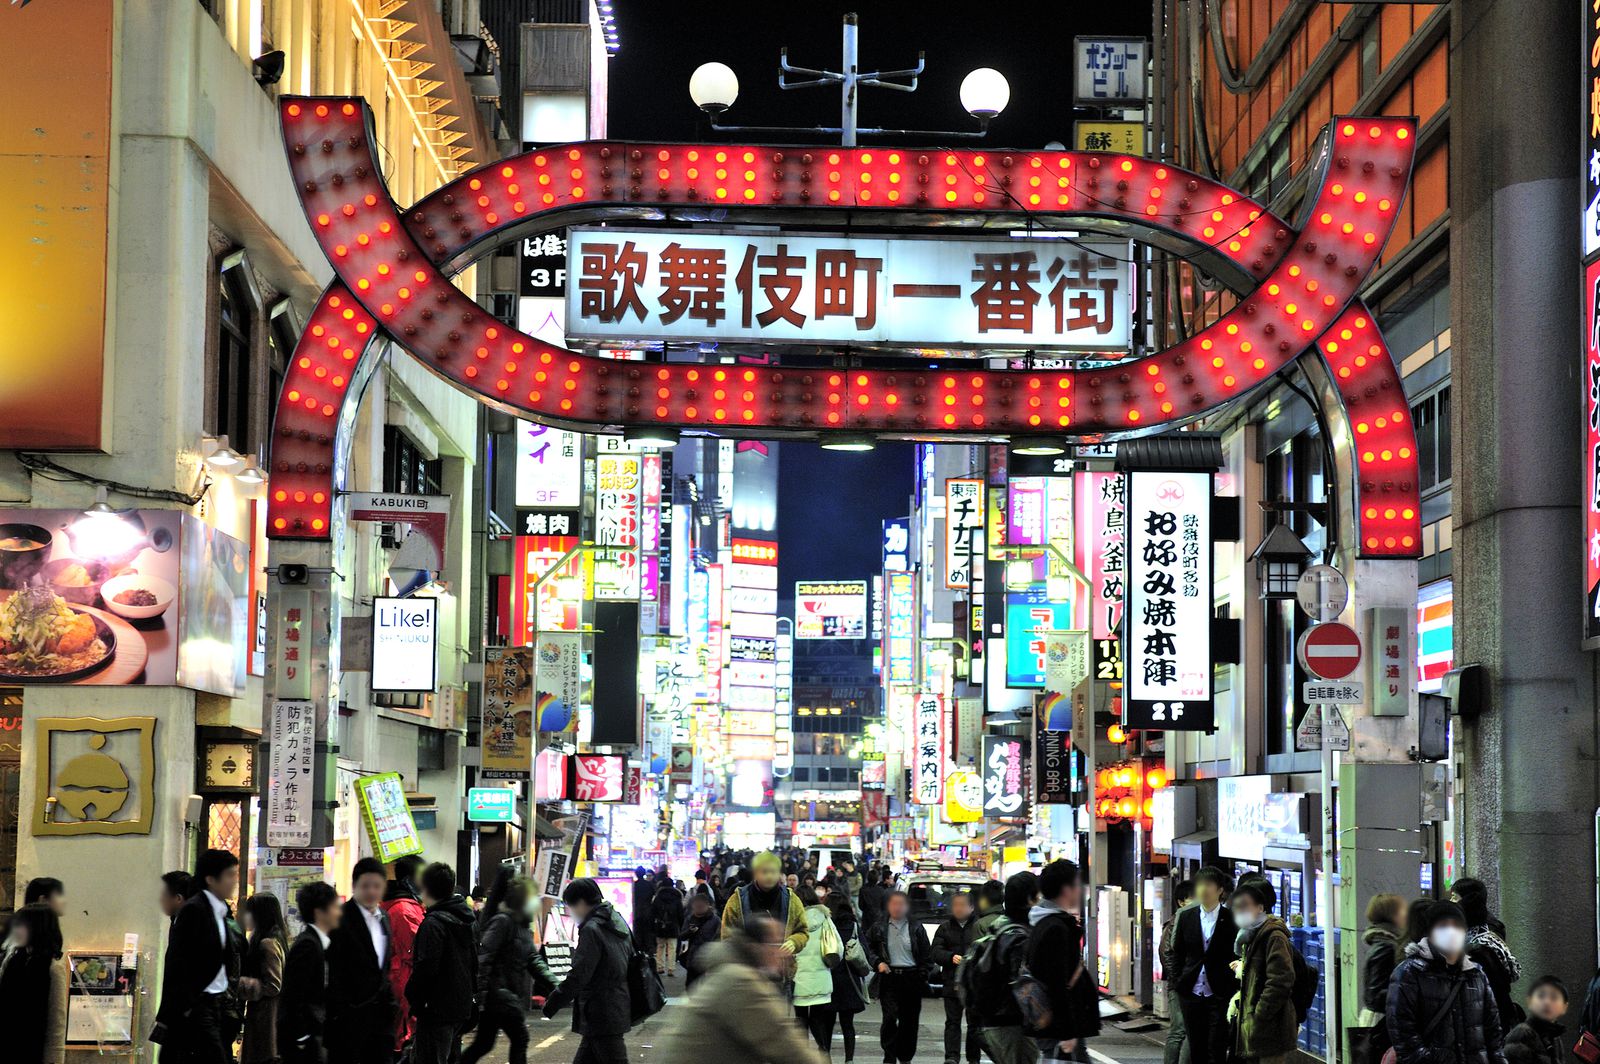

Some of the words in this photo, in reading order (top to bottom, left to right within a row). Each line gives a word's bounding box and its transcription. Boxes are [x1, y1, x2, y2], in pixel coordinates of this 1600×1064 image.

[1086, 44, 1138, 70] ポケット
[1093, 71, 1129, 97] ビル
[1126, 130, 1134, 156] エレガ
[579, 241, 1118, 334] 歌舞伎町一番街
[1053, 459, 1075, 473] 2F
[371, 498, 428, 510] KABUKI町
[536, 491, 559, 502] 3F
[951, 484, 978, 498] 東京
[526, 513, 569, 534] 焼肉
[1182, 514, 1199, 597] 歌舞伎町名物
[1143, 510, 1178, 687] お好み焼本陣
[380, 606, 430, 627] Like!
[1385, 625, 1400, 697] 劇場通り
[501, 657, 517, 741] 本格ベトナム料理
[1308, 687, 1360, 700] 自転車を除く
[275, 705, 284, 742] Security
[1152, 702, 1185, 721] 2F
[920, 700, 938, 798] 無料案内所
[273, 745, 282, 781] Camera
[284, 706, 301, 826] 防犯カメラ作動中
[1046, 770, 1061, 793] BAR
[270, 782, 281, 824] Operating
